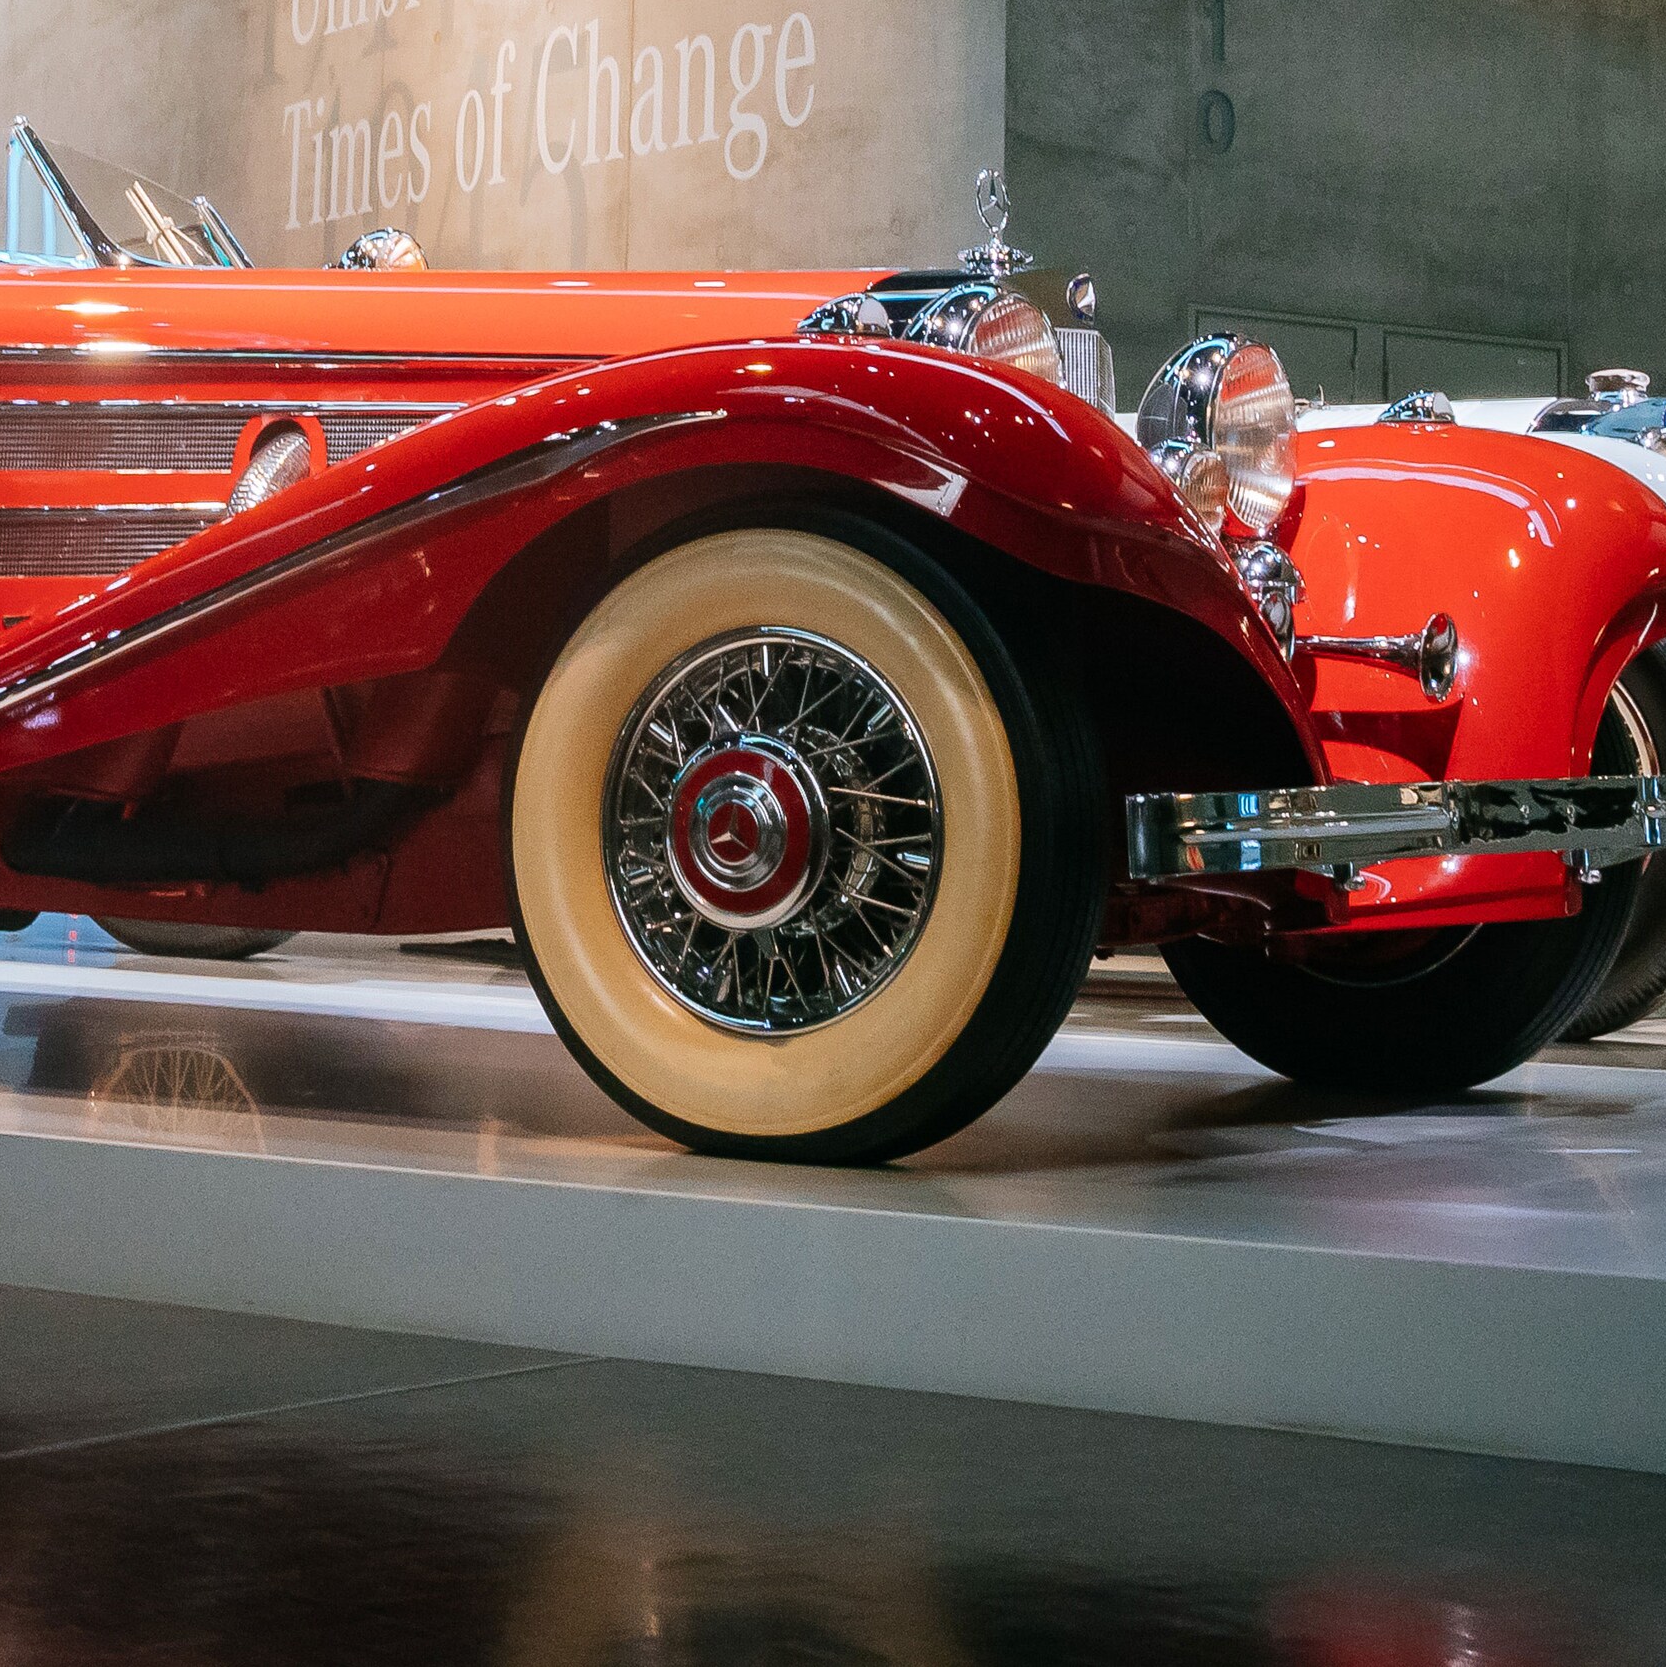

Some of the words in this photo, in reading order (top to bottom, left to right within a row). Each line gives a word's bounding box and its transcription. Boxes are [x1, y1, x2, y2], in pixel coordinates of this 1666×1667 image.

[283, 95, 434, 231] Times
[454, 36, 517, 194] of
[535, 10, 817, 182] Change
